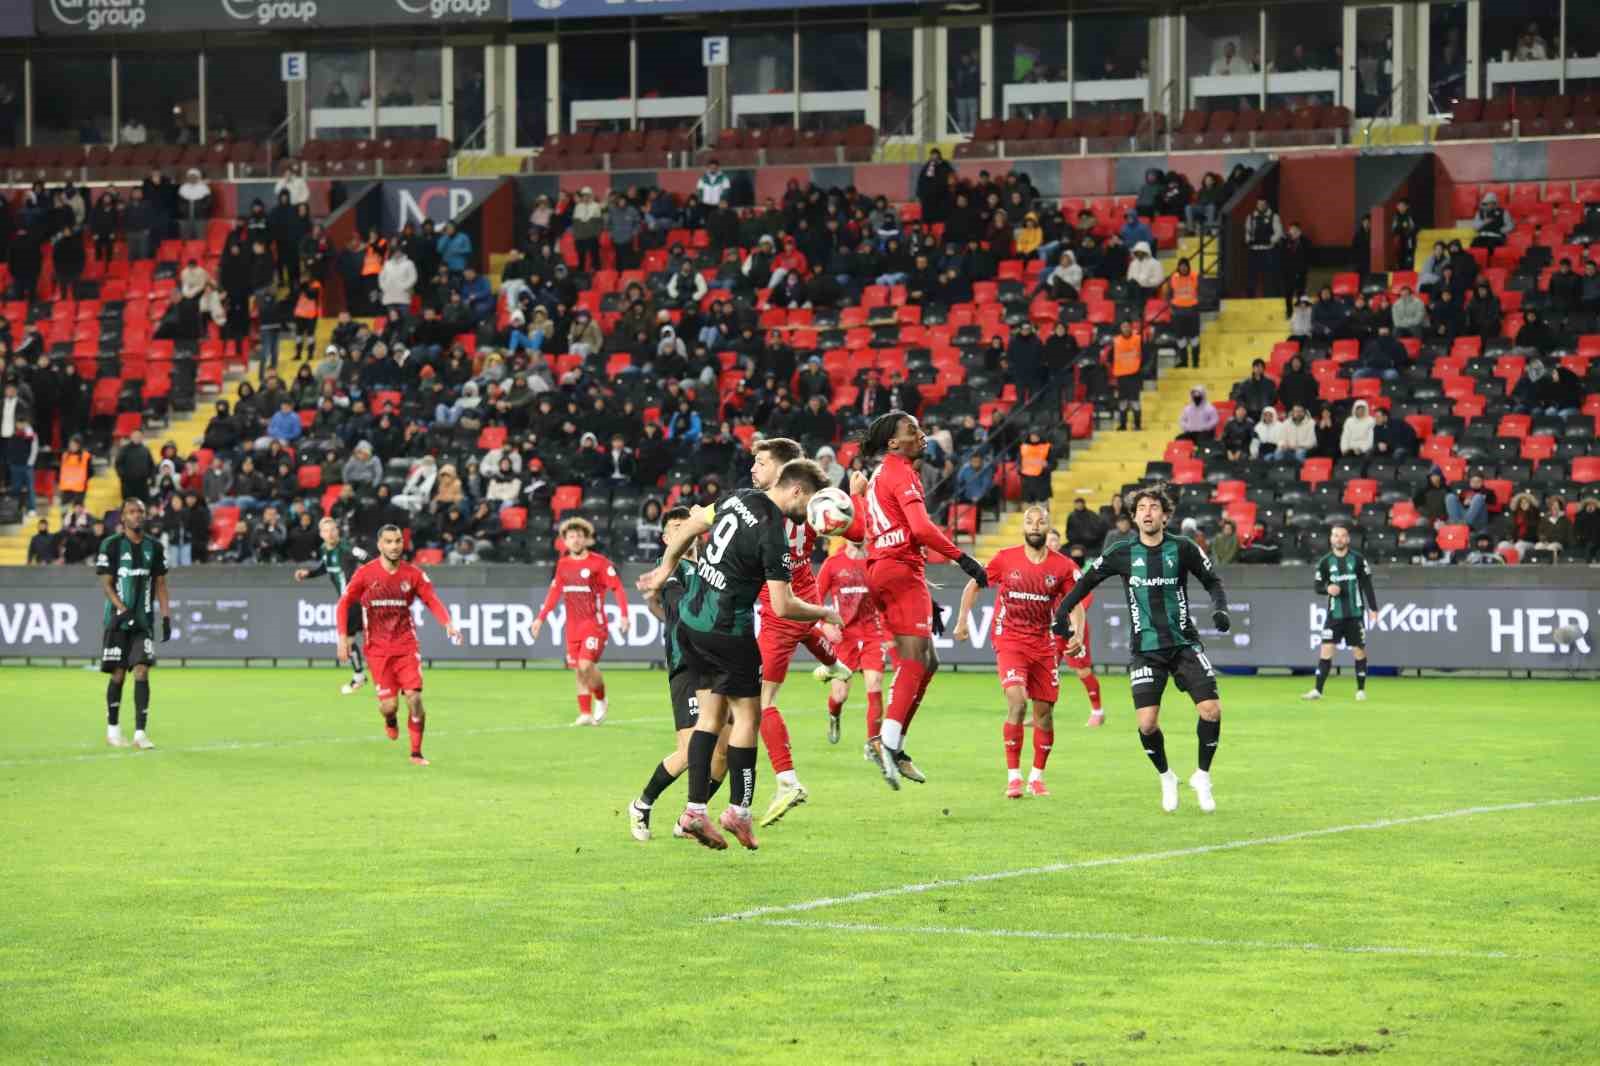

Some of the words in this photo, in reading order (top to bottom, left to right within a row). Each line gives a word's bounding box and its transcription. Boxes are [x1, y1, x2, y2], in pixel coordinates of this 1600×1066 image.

[87, 8, 146, 31] group
[258, 1, 317, 25] group
[431, 0, 490, 18] group
[708, 41, 721, 61] F
[287, 56, 299, 76] E
[705, 513, 738, 565] 9
[0, 603, 79, 645] VAR
[450, 603, 535, 646] HER
[1488, 608, 1592, 654] HER
[584, 635, 600, 650] 61
